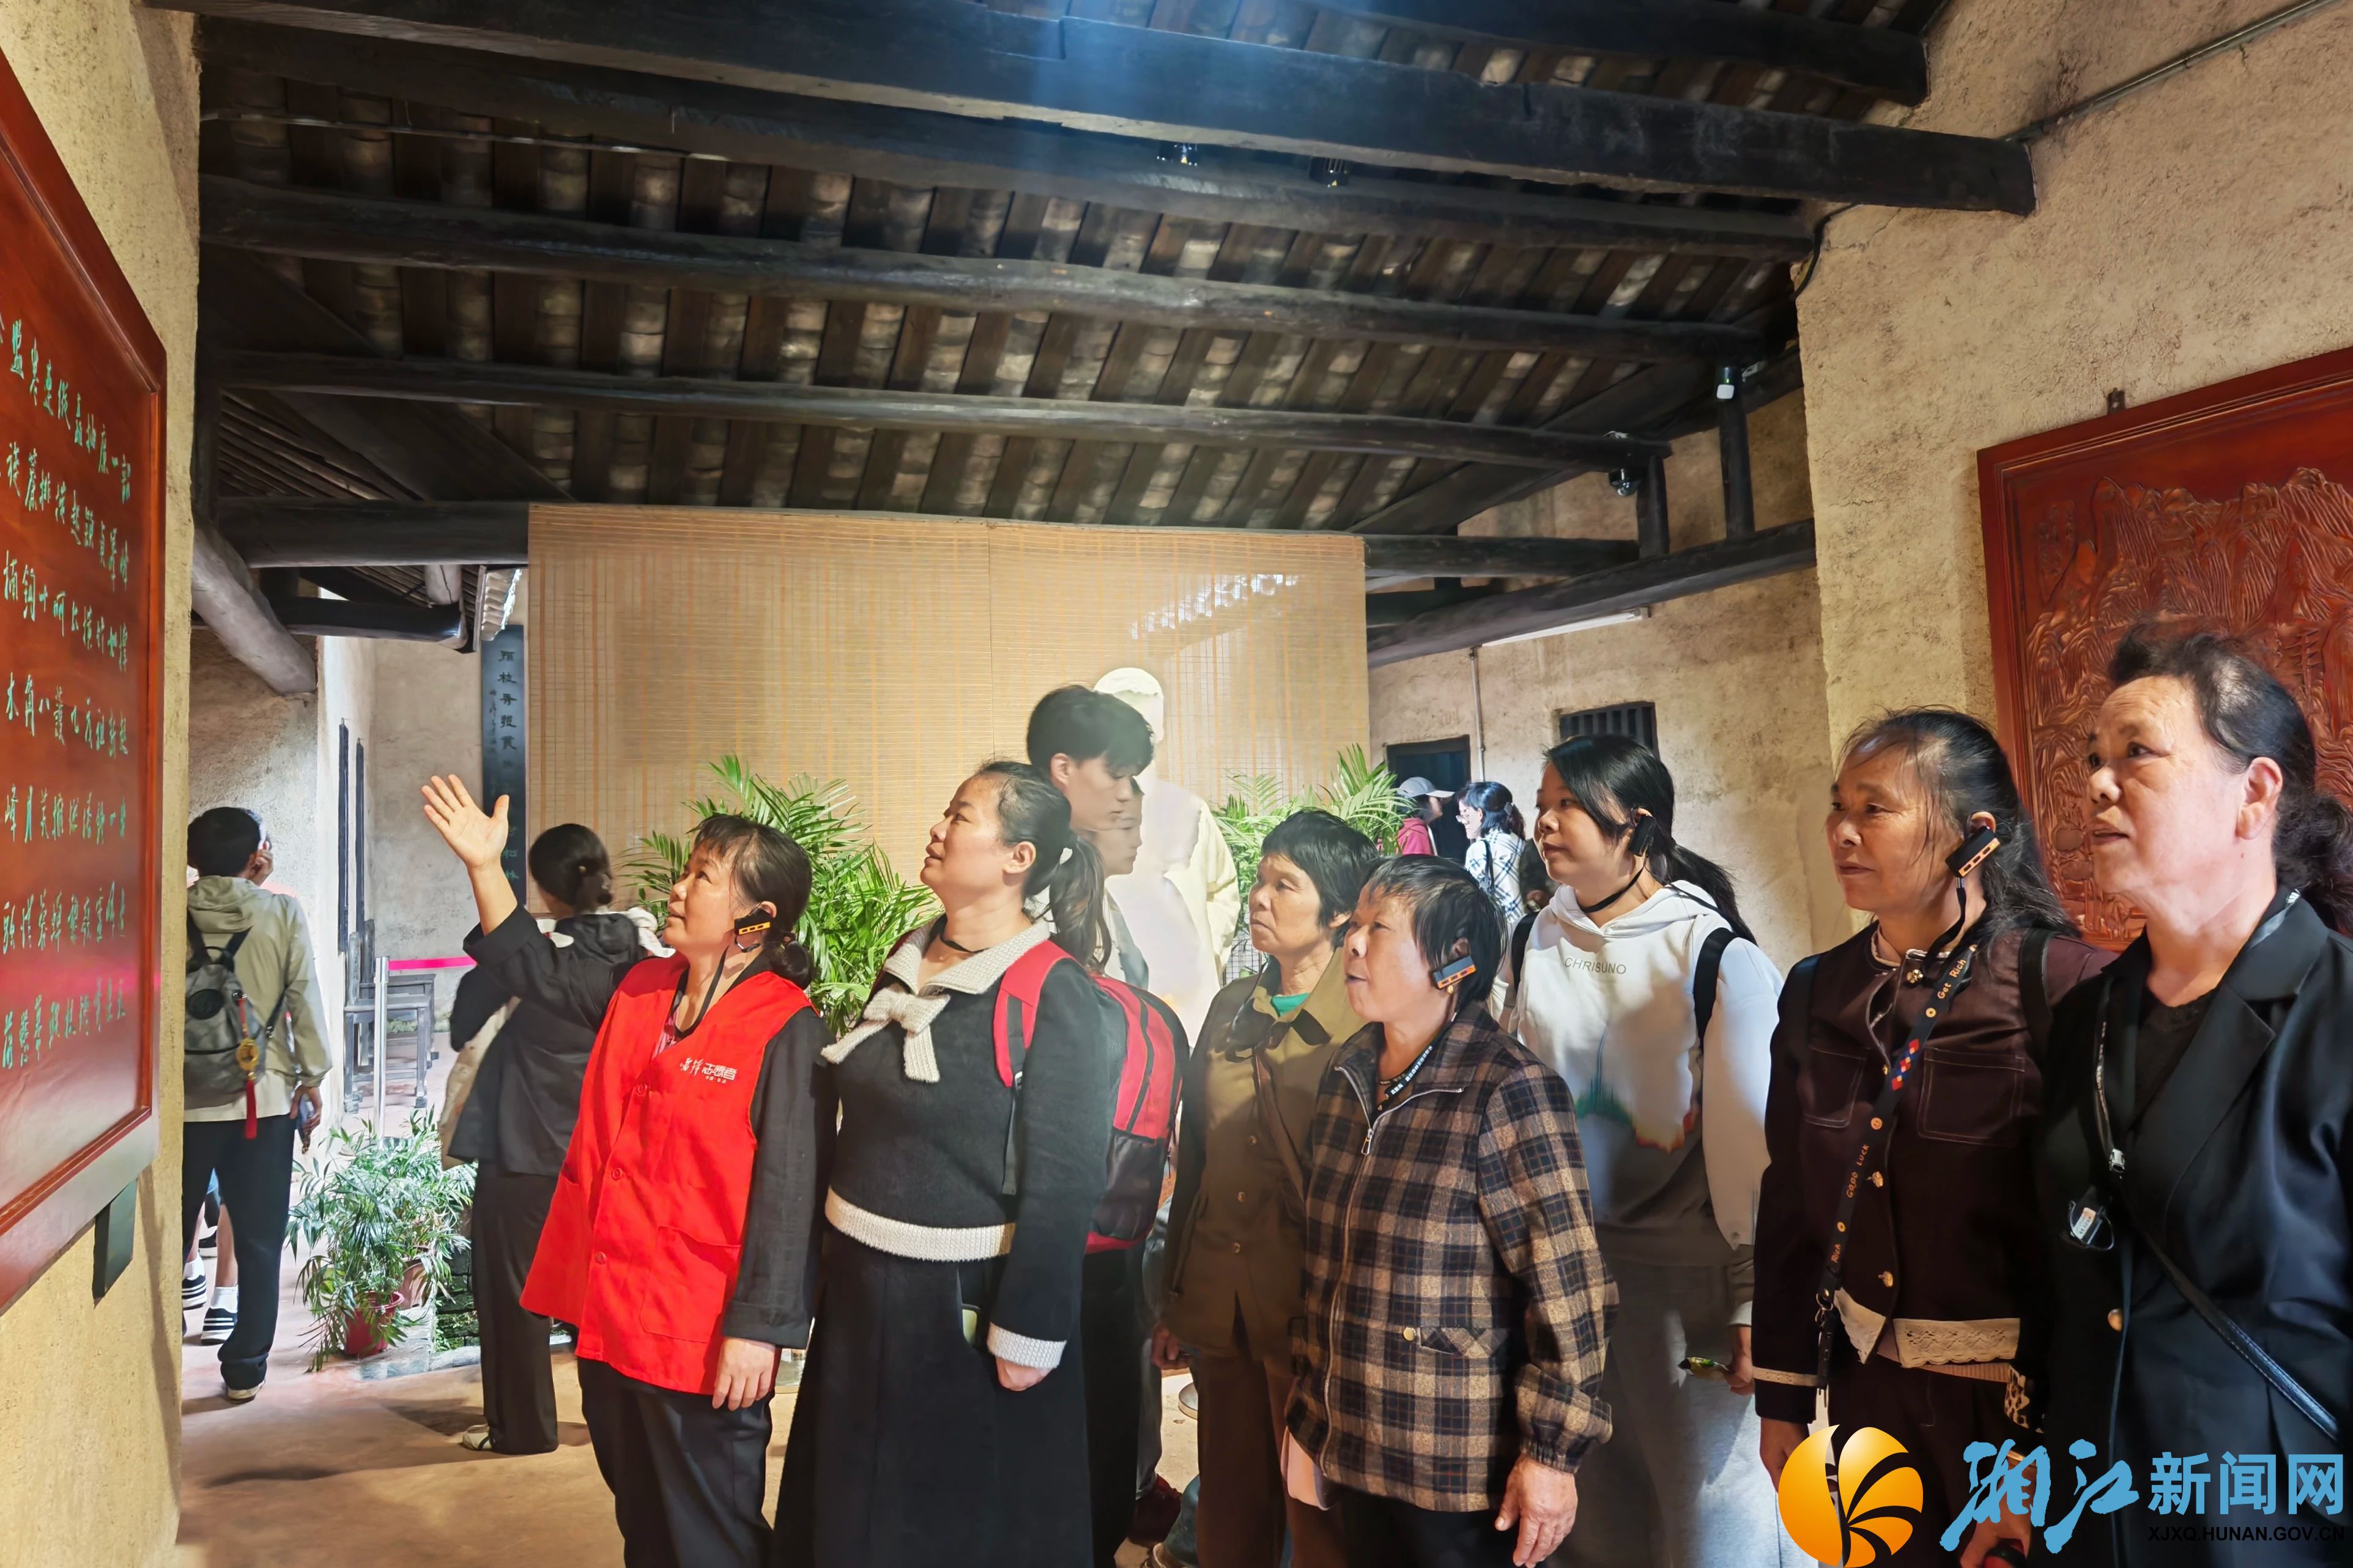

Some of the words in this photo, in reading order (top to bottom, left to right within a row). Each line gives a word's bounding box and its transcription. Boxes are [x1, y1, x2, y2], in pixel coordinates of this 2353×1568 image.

[1564, 957, 1626, 974] CHRISUNO
[1937, 982, 1952, 999] Get
[1949, 959, 1966, 977] Rich
